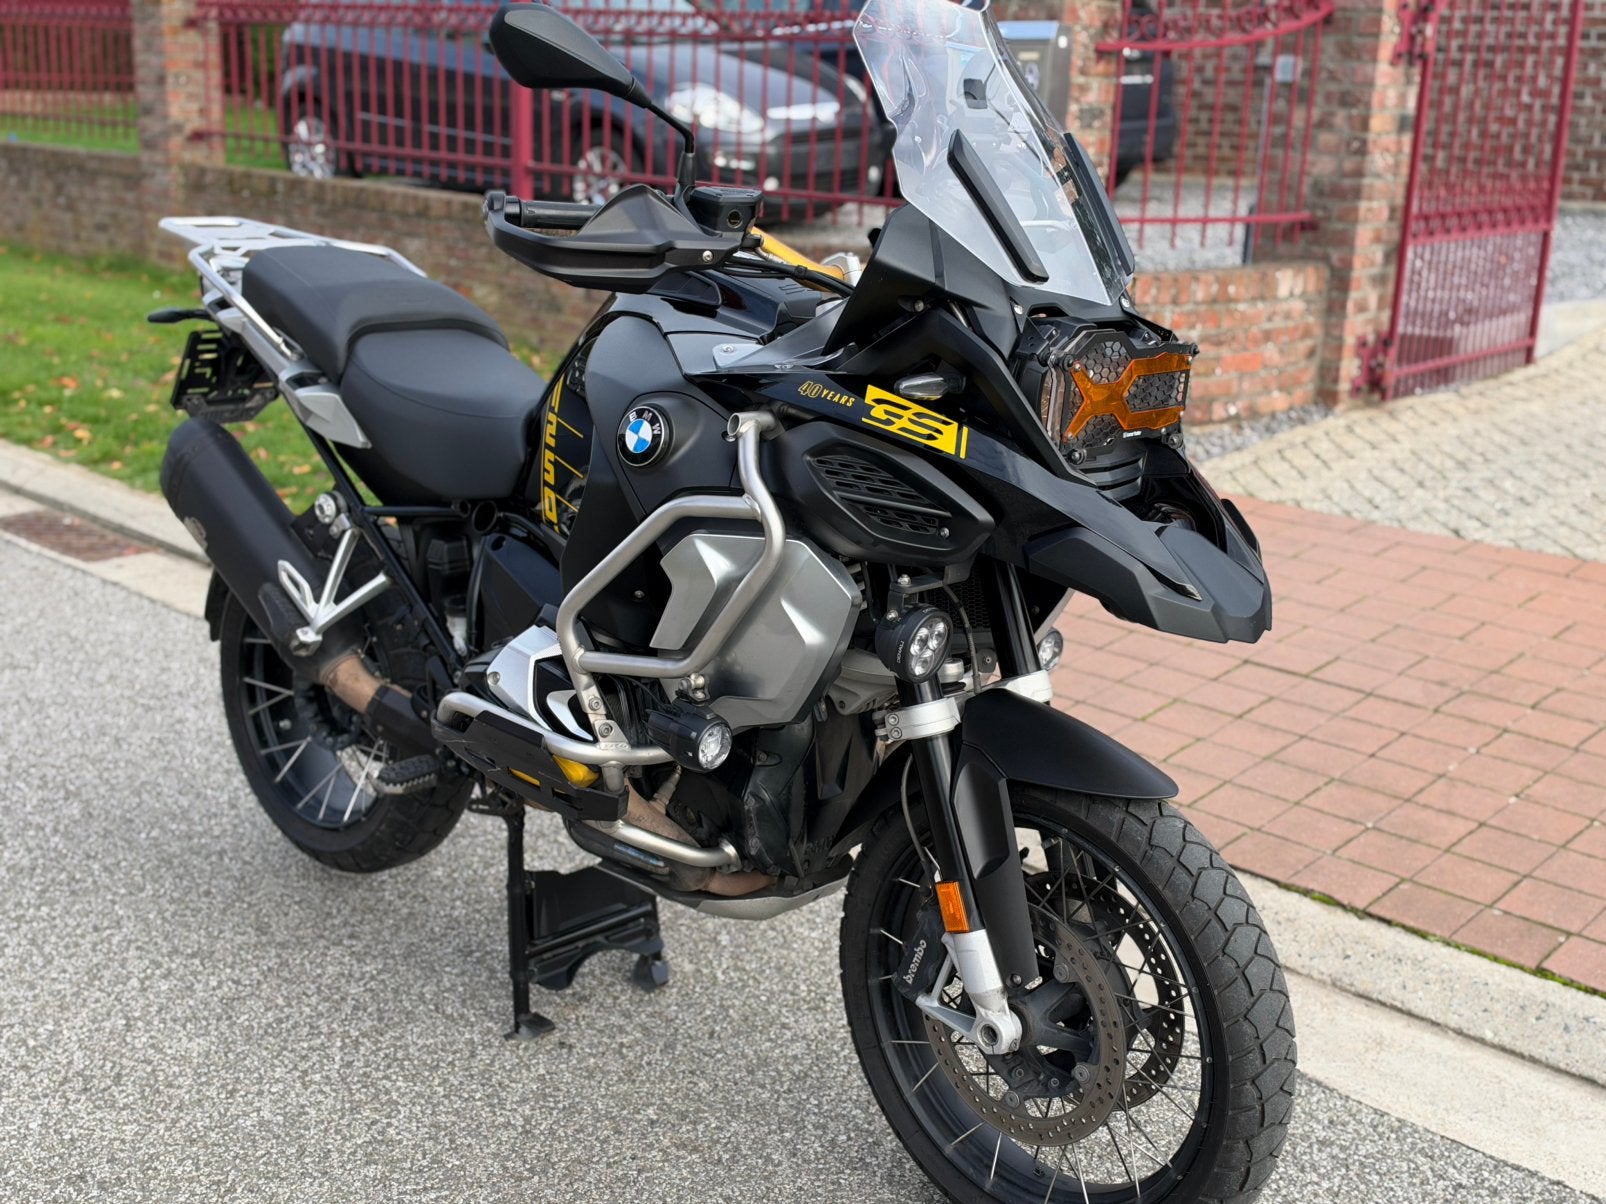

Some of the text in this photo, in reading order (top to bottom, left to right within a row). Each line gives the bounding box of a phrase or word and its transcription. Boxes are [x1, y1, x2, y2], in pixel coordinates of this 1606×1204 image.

[798, 381, 856, 406] 40 YEARS
[628, 411, 661, 435] BMW
[861, 390, 957, 448] GS
[903, 940, 927, 984] brembo
